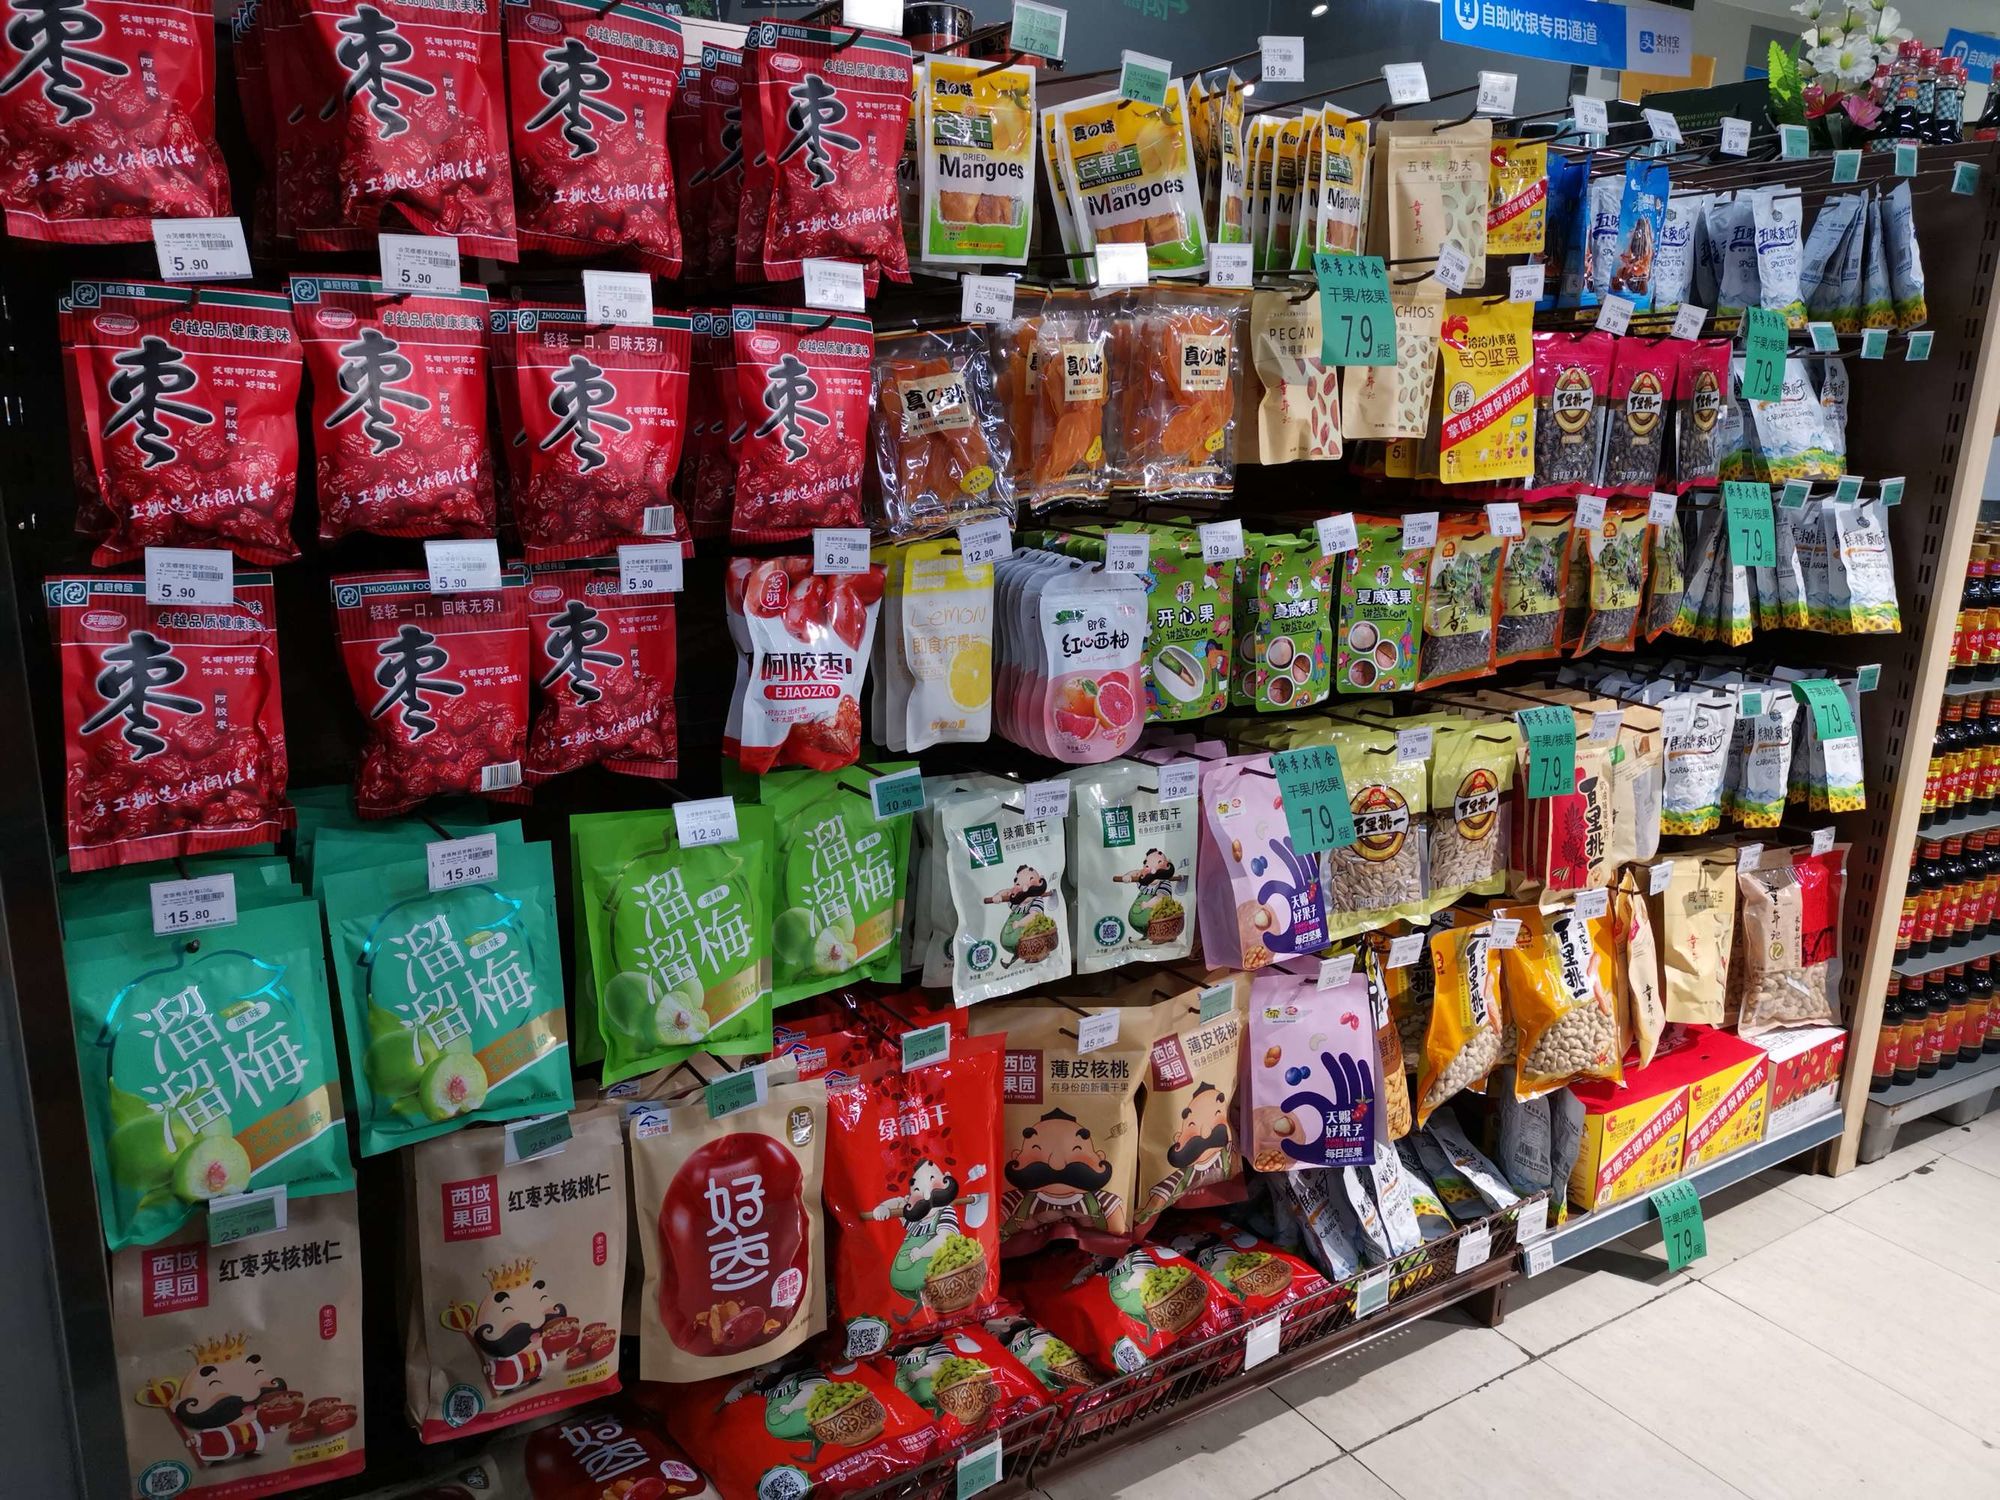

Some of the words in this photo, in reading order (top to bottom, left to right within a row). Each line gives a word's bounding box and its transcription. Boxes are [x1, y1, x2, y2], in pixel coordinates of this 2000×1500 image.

[1482, 2, 1598, 46] 自助收银专用通道
[585, 27, 679, 59] 卓越品质健康美味
[1022, 36, 1049, 52] 17.90
[1655, 33, 1680, 48] 支付宝
[140, 56, 159, 98] 阿胶枣
[336, 5, 437, 140] 枣
[824, 59, 908, 82] 卓越品质健康美味
[1265, 65, 1286, 77] 18.90
[936, 77, 973, 97] 真の味
[524, 37, 626, 160] 枣
[777, 74, 861, 189] 枣
[937, 114, 992, 139] 芒果干
[1072, 119, 1114, 142] 真の味
[1327, 124, 1346, 141] 真の味
[25, 145, 197, 188] 手工挑选休闲佳品
[963, 152, 986, 162] DRIED
[1077, 147, 1137, 178] 芒果干
[1407, 160, 1430, 173] 五味
[1449, 160, 1472, 172] 功夫
[939, 156, 1024, 180] Mangoes
[1089, 177, 1184, 217] Mangoes
[1111, 183, 1137, 196] DRIED
[174, 256, 208, 271] 5.90
[401, 269, 432, 284] 5.90
[1217, 271, 1234, 282] 6.90
[1328, 287, 1388, 304] 干果/核果
[542, 312, 582, 321] ZHUOGUAN
[602, 305, 627, 318] 5.90
[975, 302, 995, 315] 6.90
[1395, 306, 1434, 319] CHIOS
[170, 320, 291, 343] 卓越品质健康美味
[382, 312, 484, 331] 卓越品质健康美味
[544, 331, 663, 352] 轻轻一口，回味无穷！
[1269, 327, 1314, 341] PECAN
[1341, 315, 1374, 358] 7.9
[1468, 333, 1516, 349] 洽洽小黄袋
[1754, 336, 1784, 351] 干果/核果
[1067, 353, 1104, 376] 真の味
[1184, 345, 1226, 367] 真の味
[1458, 348, 1520, 368] 每日坚果
[1755, 359, 1772, 396] 7.9
[102, 334, 214, 469] 枣
[324, 327, 431, 456] 枣
[904, 384, 968, 412] 真の味
[1454, 389, 1470, 406] 鲜
[539, 354, 632, 473] 枣
[777, 353, 830, 463] 枣
[1447, 377, 1529, 439] 掌握关键保鲜技术
[225, 406, 238, 442] 阿胶枣
[1733, 506, 1771, 520] 干果/核果
[968, 548, 994, 562] 12.80
[1208, 545, 1229, 556] 19.80
[1742, 529, 1763, 561] 7.9
[827, 554, 849, 566] 6.80
[1112, 559, 1134, 570] 13.80
[161, 584, 195, 598] 5.90
[365, 585, 409, 593] ZHUOGUAN
[438, 576, 467, 589] 5.90
[629, 578, 653, 590] 5.90
[1357, 589, 1412, 605] 夏威夷果
[370, 600, 502, 620] 轻轻一口，回味无穷！
[1157, 604, 1214, 628] 开心果
[1273, 599, 1318, 619] 夏威夷果
[1088, 618, 1107, 630] 即食
[540, 599, 624, 705] 枣
[912, 633, 981, 655] 即食柠檬片
[1062, 629, 1129, 658] 红心西柚
[762, 653, 845, 682] 阿胶枣
[371, 624, 465, 742] 枣
[775, 686, 837, 699] EJIAOZAO
[79, 630, 203, 762] 枣
[214, 693, 228, 729] 阿胶枣
[1821, 704, 1843, 734] 7.9
[1534, 732, 1573, 748] 干果/核果
[1541, 756, 1561, 792] 7.9
[1167, 785, 1187, 796] 19.00
[1288, 778, 1341, 796] 干果/核果
[886, 798, 912, 811] 10.90
[1036, 804, 1058, 815] 19.00
[1105, 809, 1131, 824] 西域
[1138, 807, 1182, 824] 绿葡萄干
[1354, 817, 1406, 832] 百里挑一
[1579, 777, 1604, 870] 百里挑一
[691, 827, 722, 842] 12.50
[968, 827, 994, 844] 西域
[1003, 821, 1048, 840] 绿葡萄干
[1107, 826, 1131, 840] 果园
[1301, 805, 1335, 847] 7.9
[971, 843, 996, 859] 果园
[445, 865, 481, 881] 15.80
[1291, 893, 1308, 907] 天赐
[168, 909, 210, 924] 15.80
[1293, 906, 1317, 923] 好果子
[631, 866, 754, 1005] 溜溜梅
[1295, 932, 1321, 946] 每日坚果
[475, 937, 501, 956] 原味
[389, 913, 537, 1067] 溜溜梅
[234, 1008, 262, 1026] 原味
[1186, 1021, 1238, 1054] 薄皮核桃
[133, 985, 309, 1153] 溜溜梅
[1051, 1060, 1129, 1078] 薄皮核桃
[1051, 1082, 1129, 1093] 有身份的新疆干果
[1326, 1111, 1351, 1124] 天赐
[1690, 1067, 1765, 1151] 掌握关键保鲜技术
[879, 1104, 950, 1142] 绿葡萄干
[1326, 1124, 1364, 1138] 好果子
[1601, 1100, 1683, 1180] 掌握关键保鲜技术
[1325, 1148, 1363, 1158] 每日坚果
[451, 1183, 490, 1204] 西域
[508, 1174, 611, 1211] 红枣夹核桃仁
[453, 1207, 492, 1227] 果园
[1665, 1206, 1698, 1226] 干果/核果
[704, 1174, 771, 1291] 好枣
[1673, 1229, 1693, 1264] 7.9
[152, 1250, 198, 1275] 西域
[219, 1241, 342, 1282] 红枣夹核桃仁
[152, 1276, 198, 1299] 果园
[777, 1272, 798, 1290] 香酥
[561, 1416, 650, 1479] 好枣
